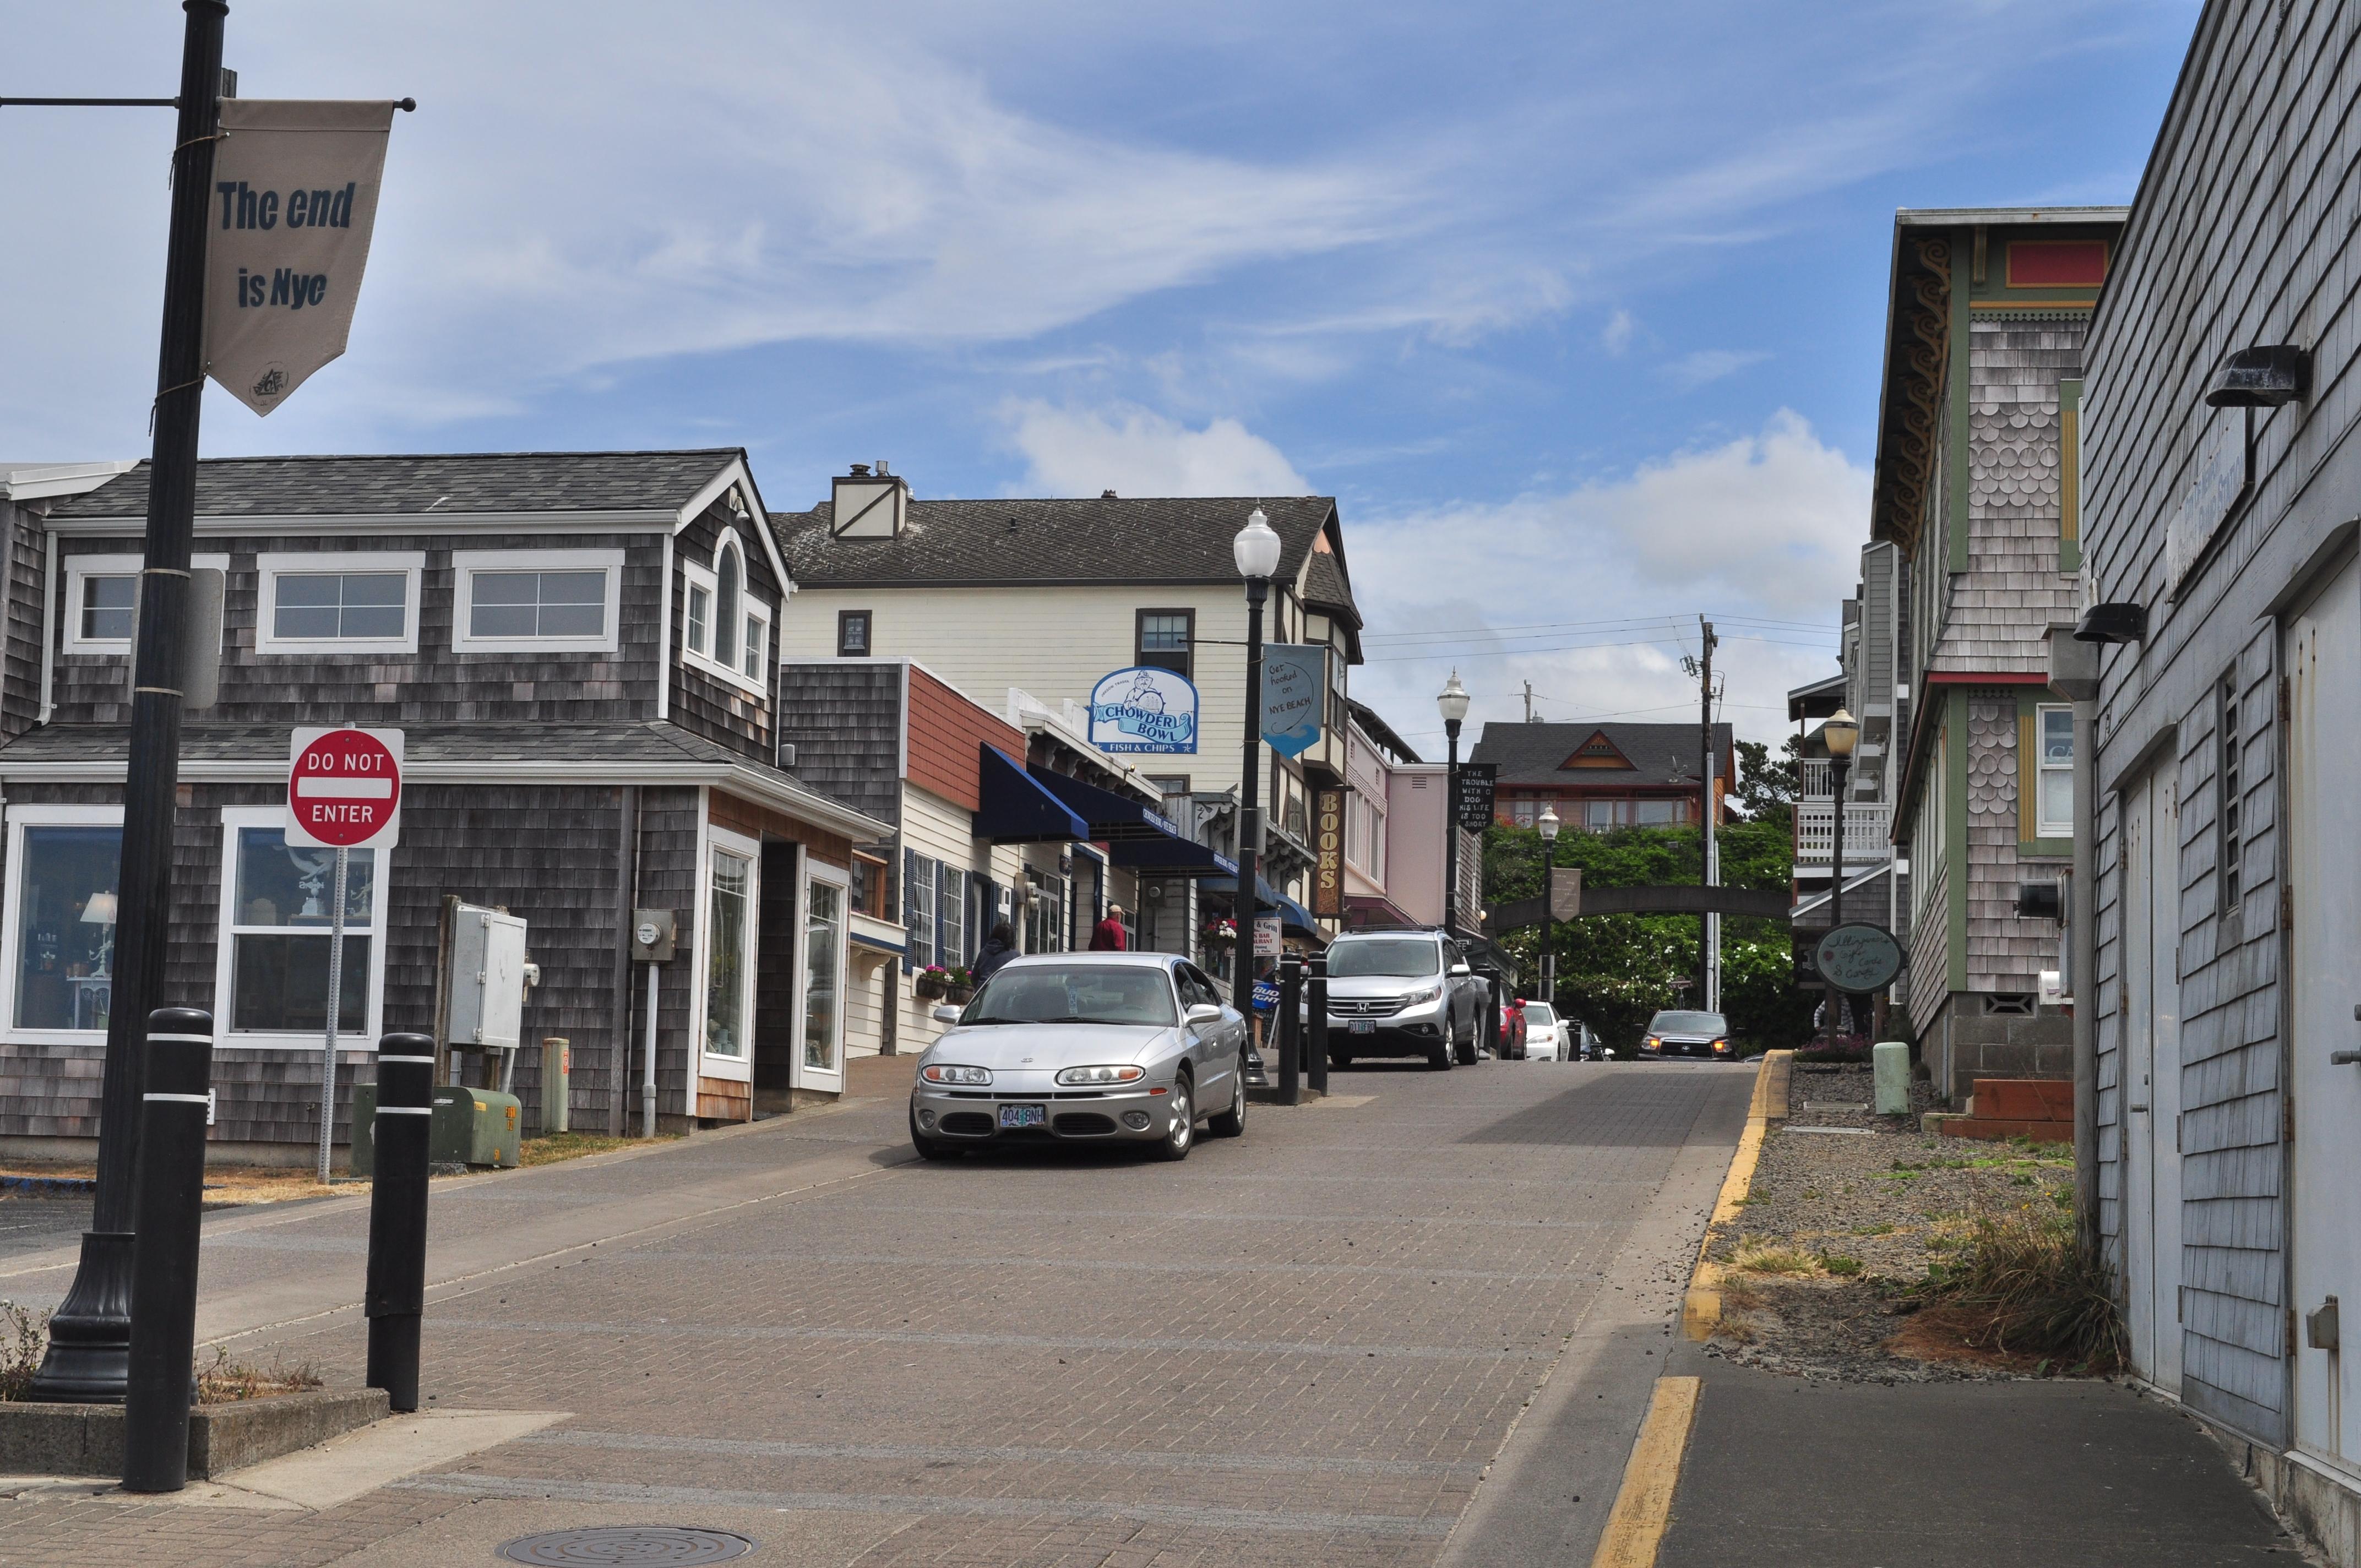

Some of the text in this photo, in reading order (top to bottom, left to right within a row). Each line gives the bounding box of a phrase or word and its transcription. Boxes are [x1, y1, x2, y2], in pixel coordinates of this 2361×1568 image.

[217, 181, 356, 230] The end
[238, 268, 328, 310] is Nye
[1269, 664, 1285, 674] Get
[1270, 671, 1297, 685] hooked
[1269, 696, 1310, 715] NYE BEACH
[1105, 706, 1172, 727] CHOWDER
[1137, 723, 1177, 742] BOWL
[1134, 744, 1141, 752] &
[308, 753, 384, 771] DO NOT
[312, 805, 373, 823] ENTER
[1319, 794, 1339, 889] BOOKS
[1263, 922, 1277, 933] Grill
[1252, 986, 1280, 997] BUD
[1252, 993, 1280, 1003] IGHT
[1002, 1109, 1043, 1122] 404 BNH
